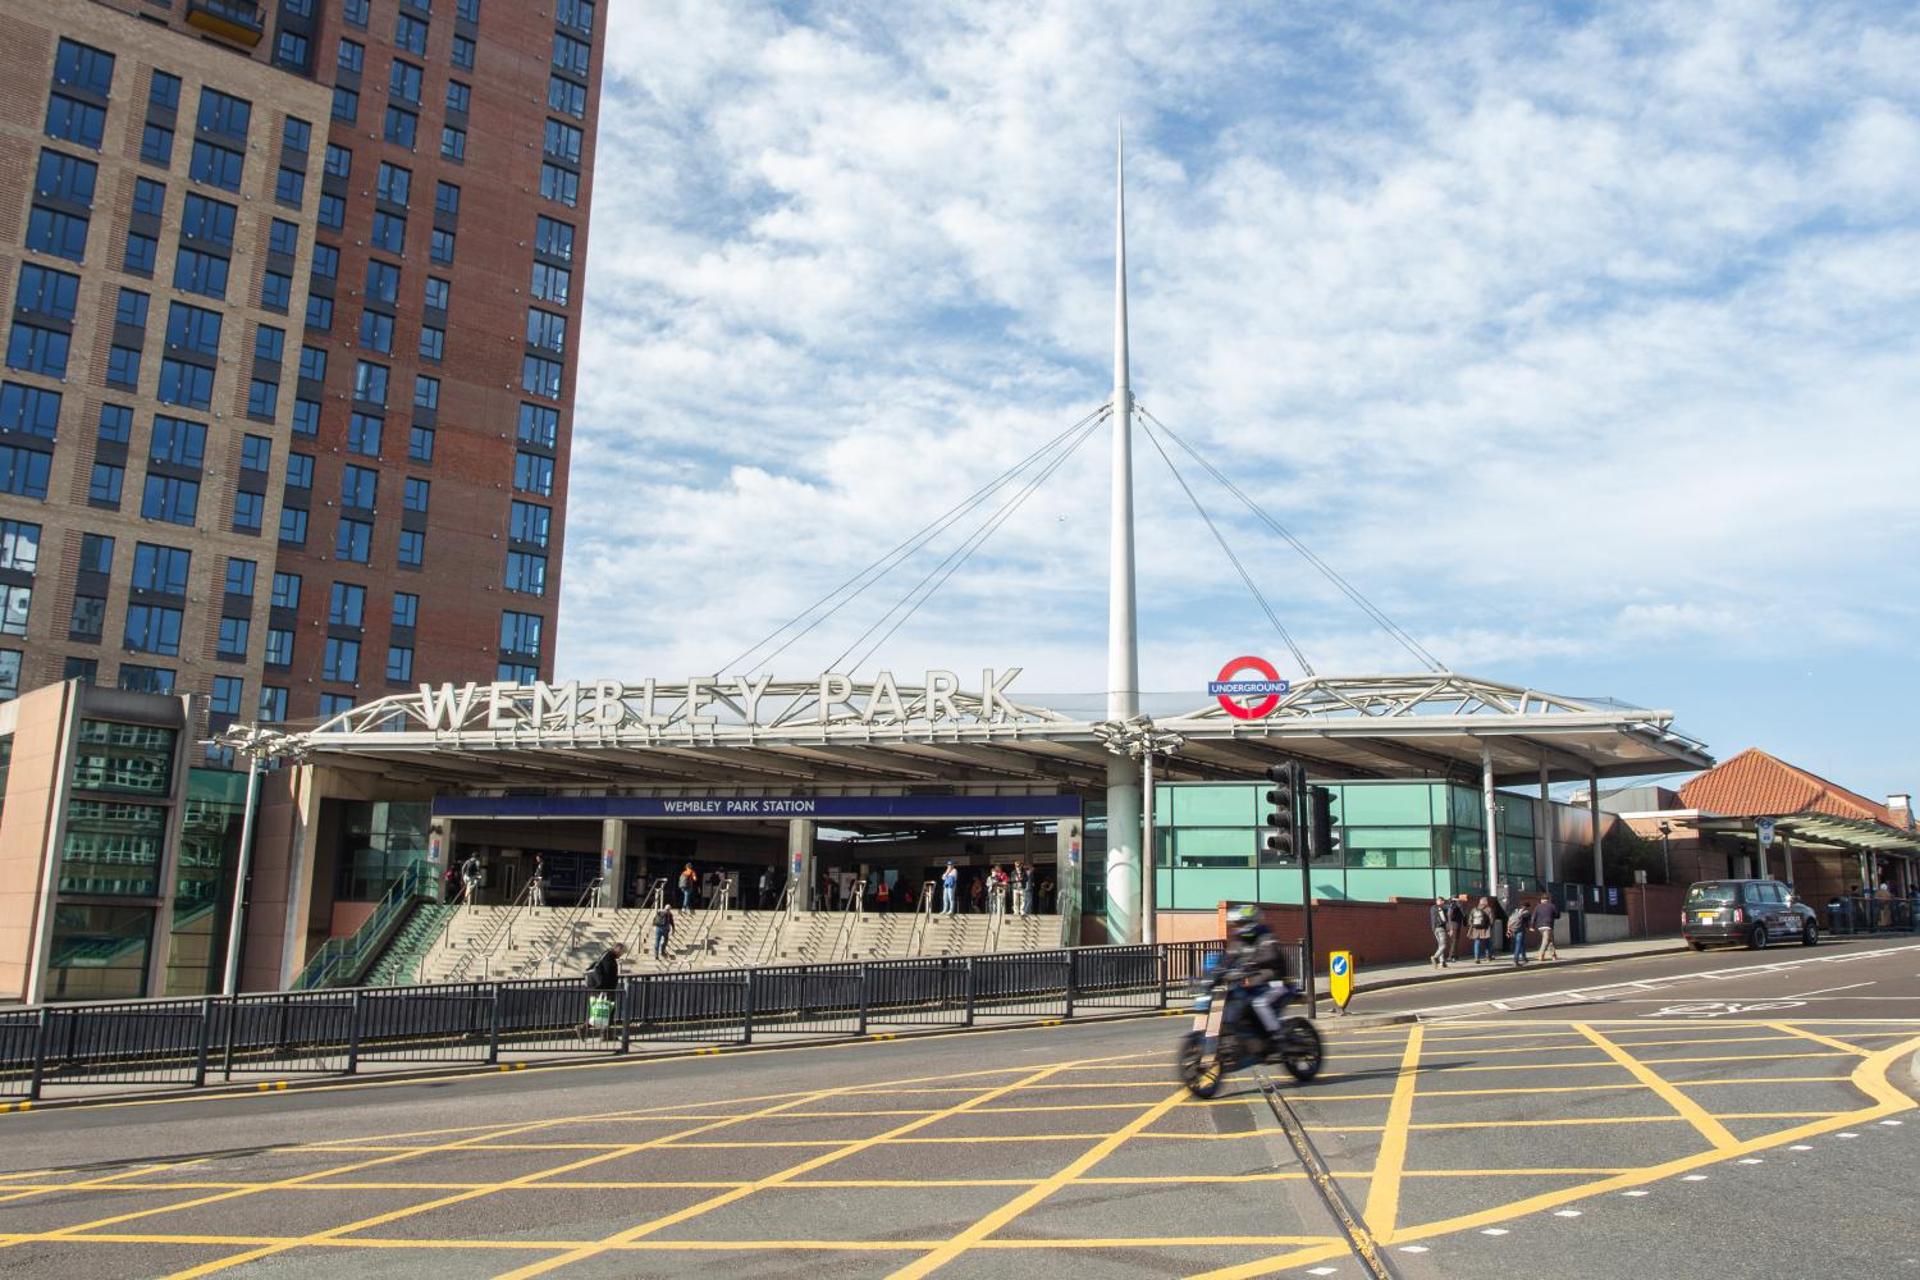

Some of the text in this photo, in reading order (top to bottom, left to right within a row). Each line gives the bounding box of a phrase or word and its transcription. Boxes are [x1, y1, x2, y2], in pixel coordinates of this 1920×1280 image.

[1211, 683, 1286, 692] UNDERGROUND
[419, 668, 1024, 730] WEMBLEY PARK
[664, 800, 815, 812] WEMBLEY PARK STATION
